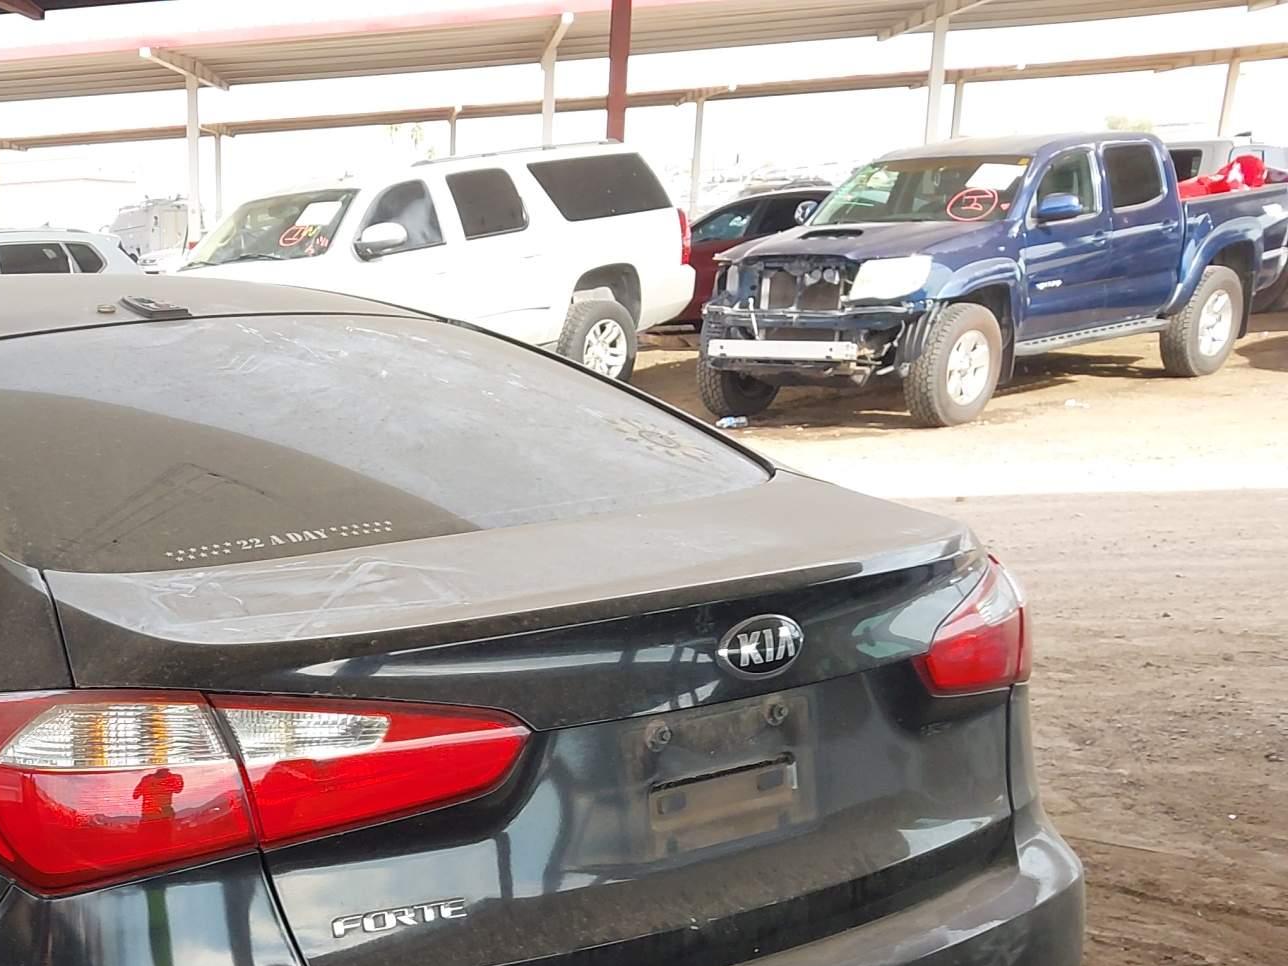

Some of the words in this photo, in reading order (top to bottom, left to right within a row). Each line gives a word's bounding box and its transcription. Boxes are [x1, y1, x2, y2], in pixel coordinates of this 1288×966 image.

[235, 536, 265, 550] 22
[269, 534, 285, 546] A
[285, 528, 328, 544] DAY
[736, 625, 796, 668] KIA
[331, 897, 468, 939] FORTE
